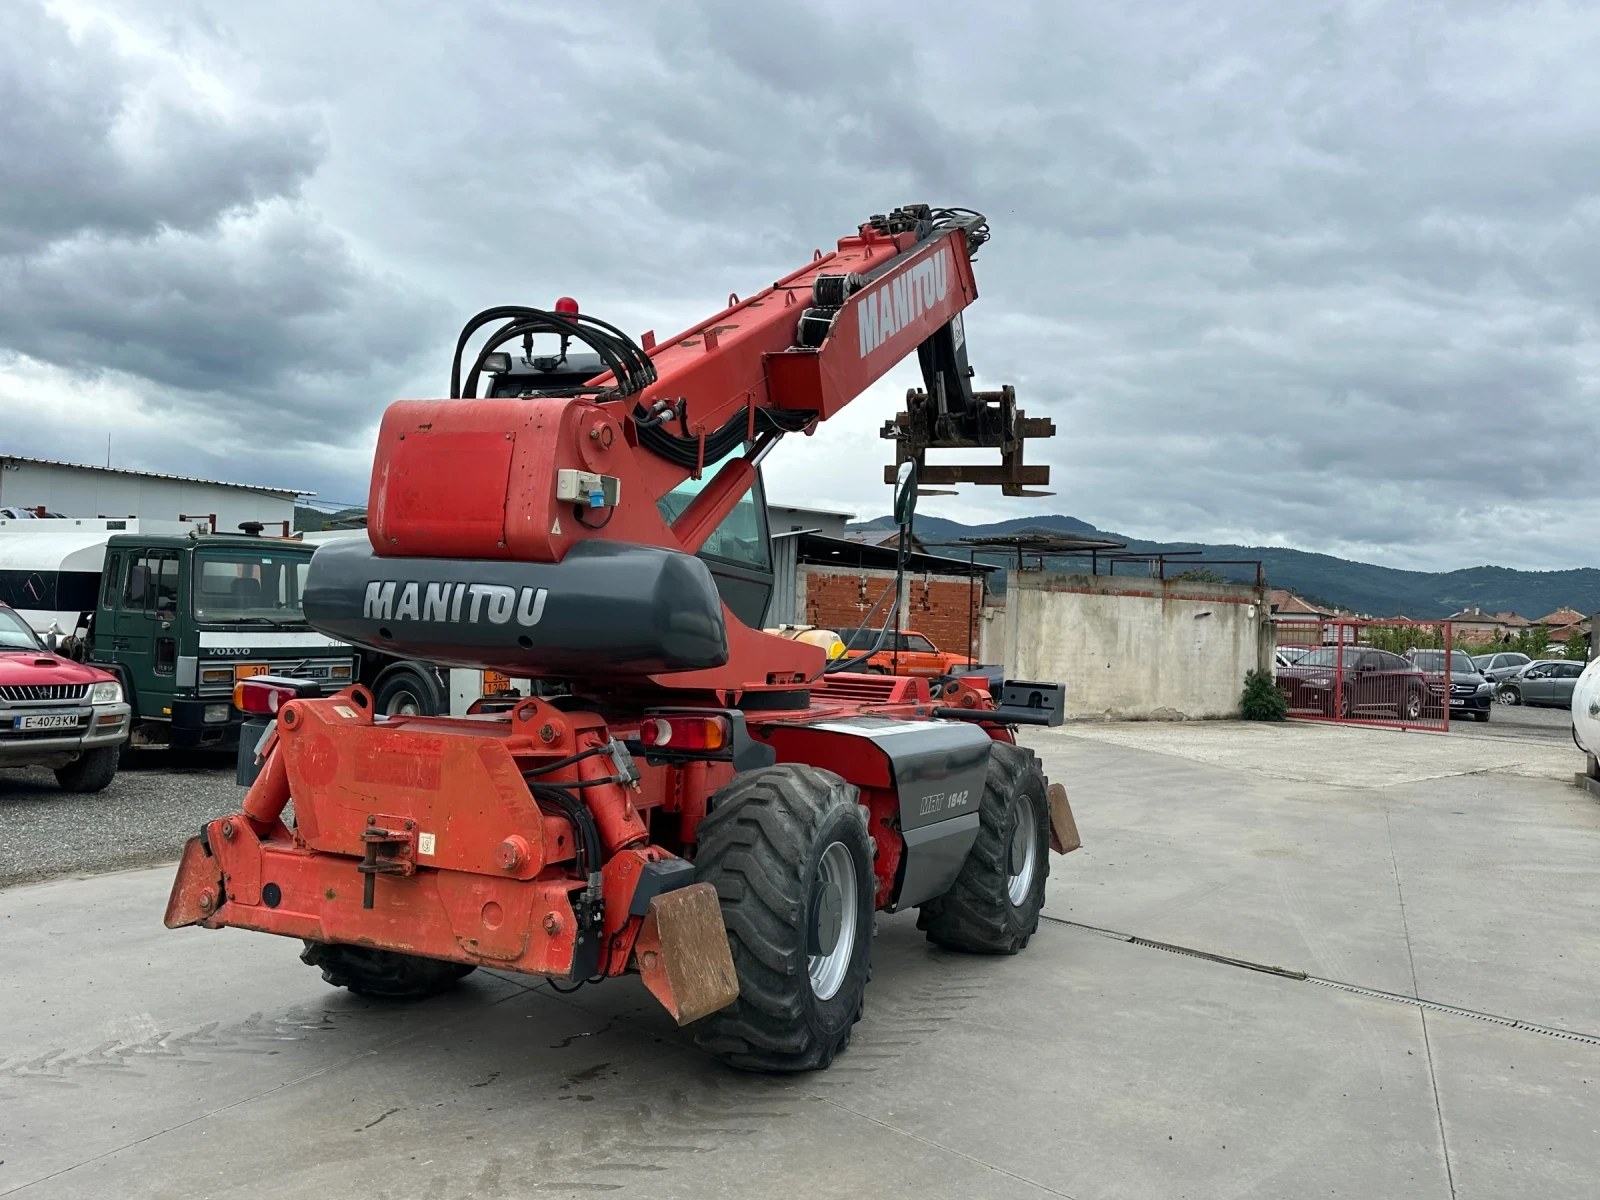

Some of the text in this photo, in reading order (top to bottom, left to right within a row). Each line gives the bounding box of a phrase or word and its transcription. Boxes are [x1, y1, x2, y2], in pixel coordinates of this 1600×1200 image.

[857, 247, 947, 359] MANITOU
[363, 581, 548, 627] MANITOU
[208, 647, 251, 656] VOLVO
[947, 790, 969, 809] 1842
